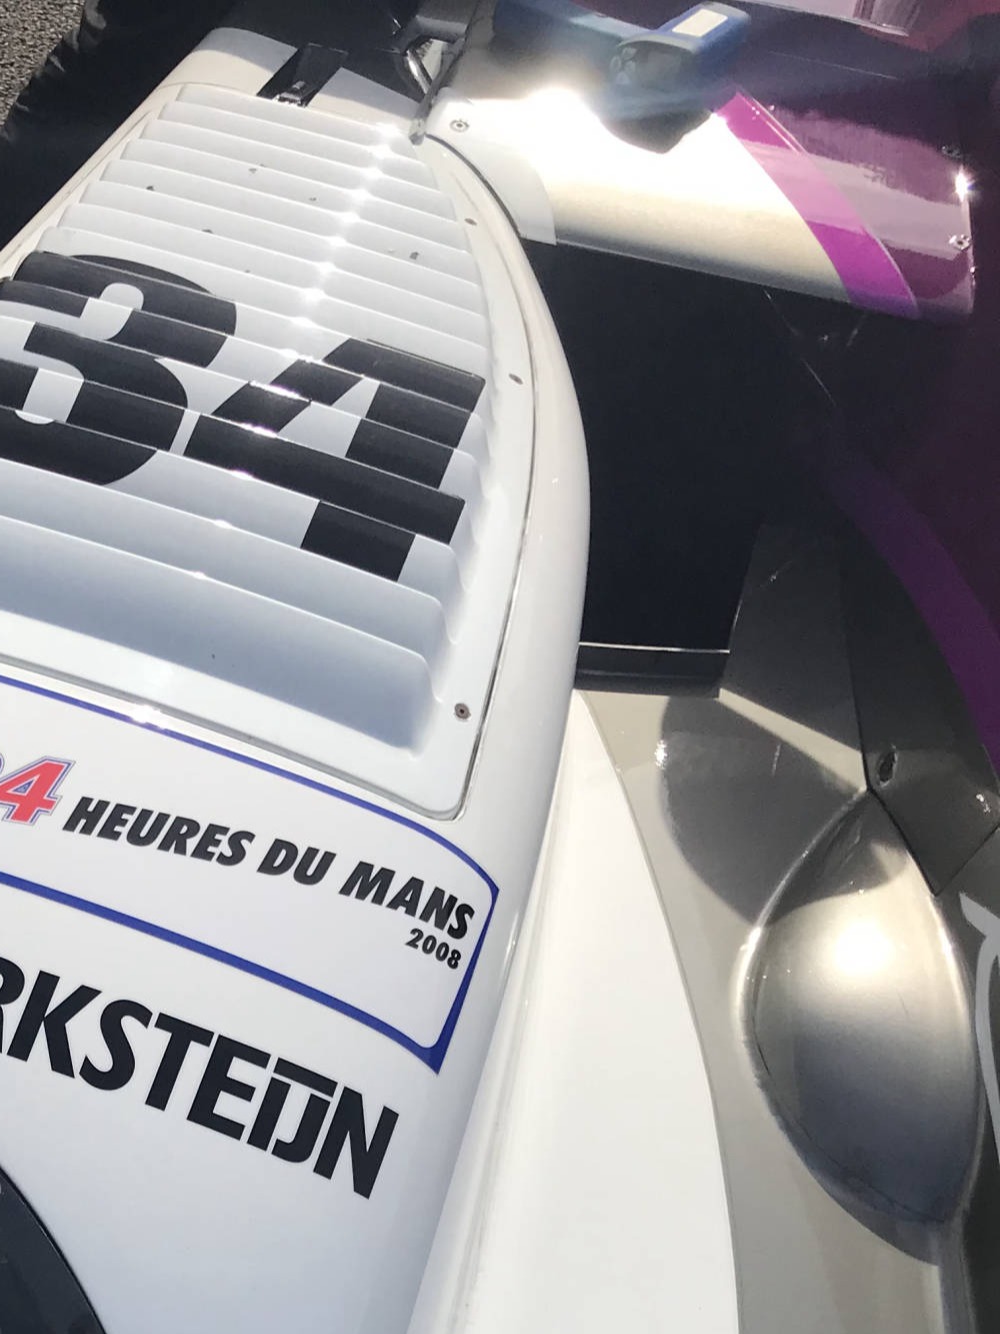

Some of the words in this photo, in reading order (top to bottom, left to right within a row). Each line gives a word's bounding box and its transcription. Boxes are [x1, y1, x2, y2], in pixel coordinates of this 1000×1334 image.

[64, 797, 253, 866] HEURES
[258, 839, 336, 886] DU
[341, 862, 474, 938] MANS
[406, 929, 462, 970] 2008
